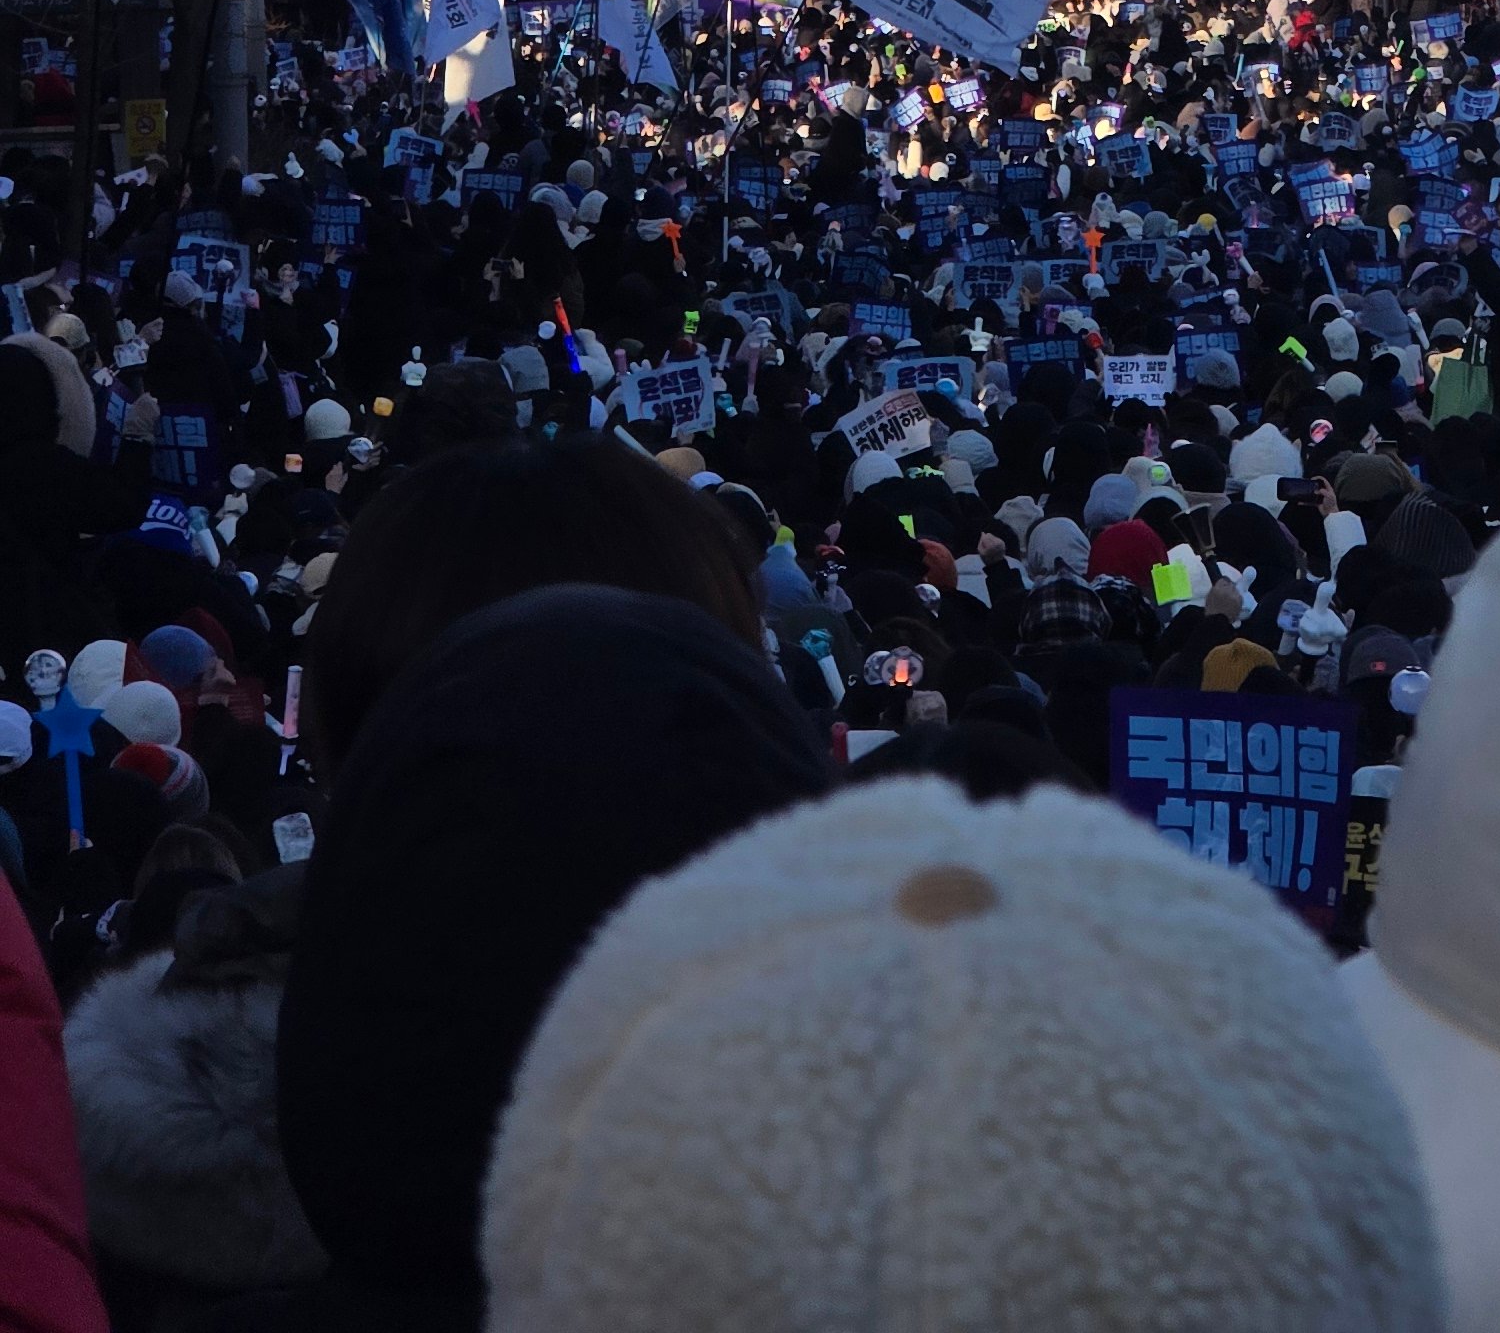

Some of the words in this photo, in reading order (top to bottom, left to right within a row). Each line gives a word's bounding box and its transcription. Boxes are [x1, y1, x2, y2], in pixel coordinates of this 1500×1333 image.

[637, 366, 701, 403] 윤석열
[1107, 361, 1140, 373] 우리가
[1112, 373, 1134, 385] 먹고
[1128, 715, 1341, 805] 국민의힘
[1156, 796, 1319, 892] 해체!
